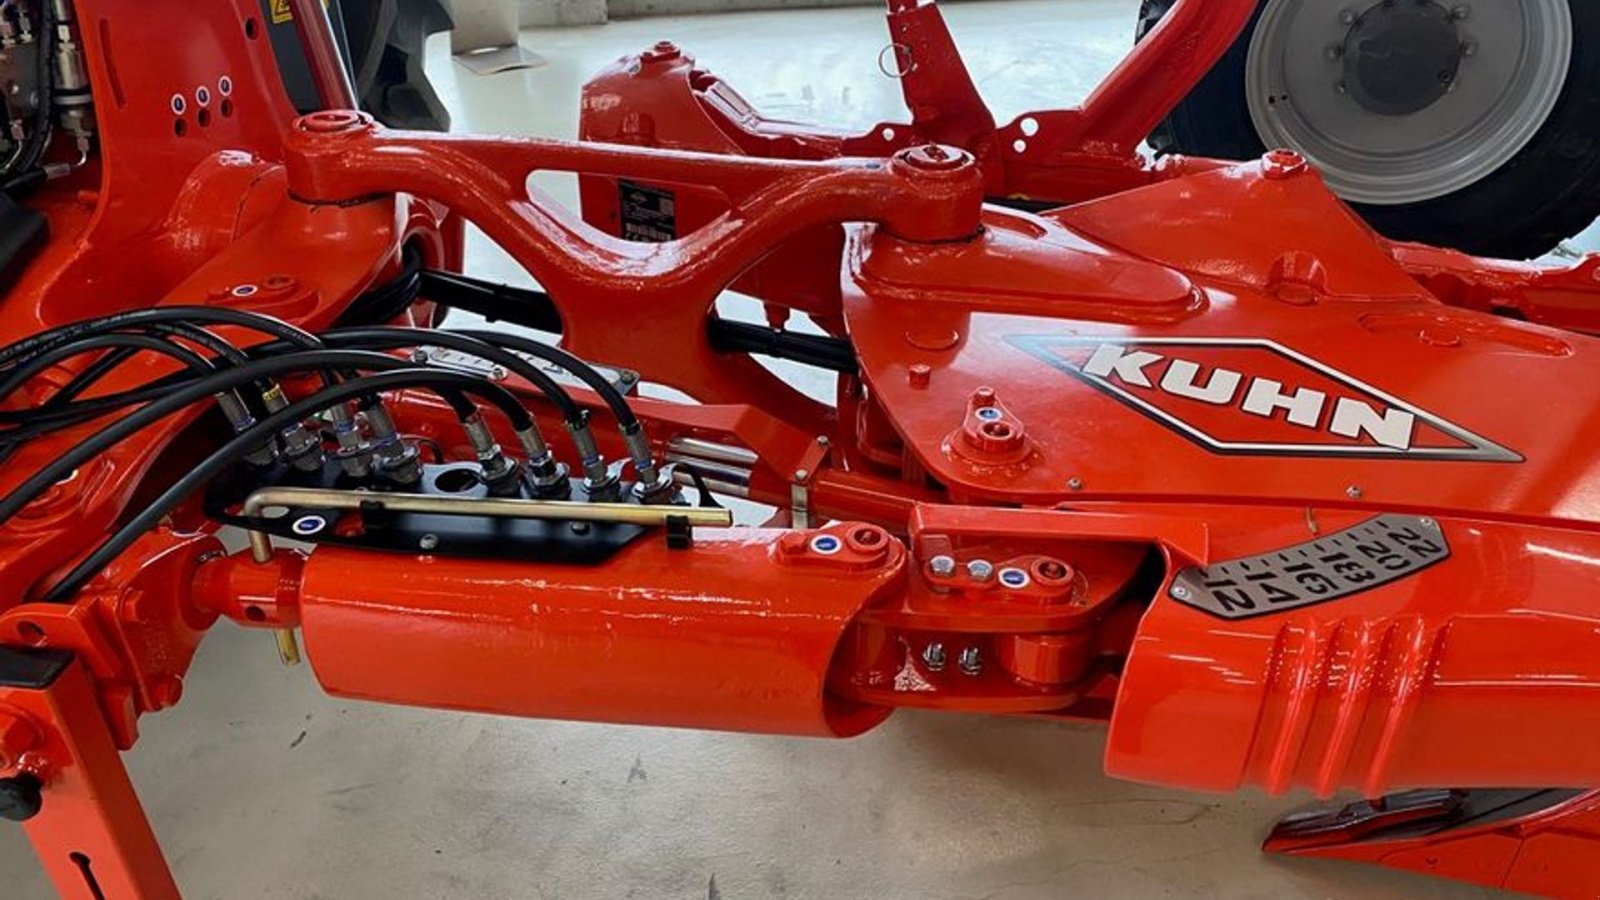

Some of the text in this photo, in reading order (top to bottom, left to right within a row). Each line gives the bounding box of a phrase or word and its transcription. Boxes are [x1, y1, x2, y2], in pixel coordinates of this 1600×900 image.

[1083, 343, 1415, 450] KUHN
[1357, 541, 1411, 571] 20
[1388, 528, 1442, 558] 22
[1284, 563, 1338, 594] 16
[1320, 553, 1375, 583] 18
[1205, 580, 1256, 611] 12
[1245, 568, 1299, 603] 14
